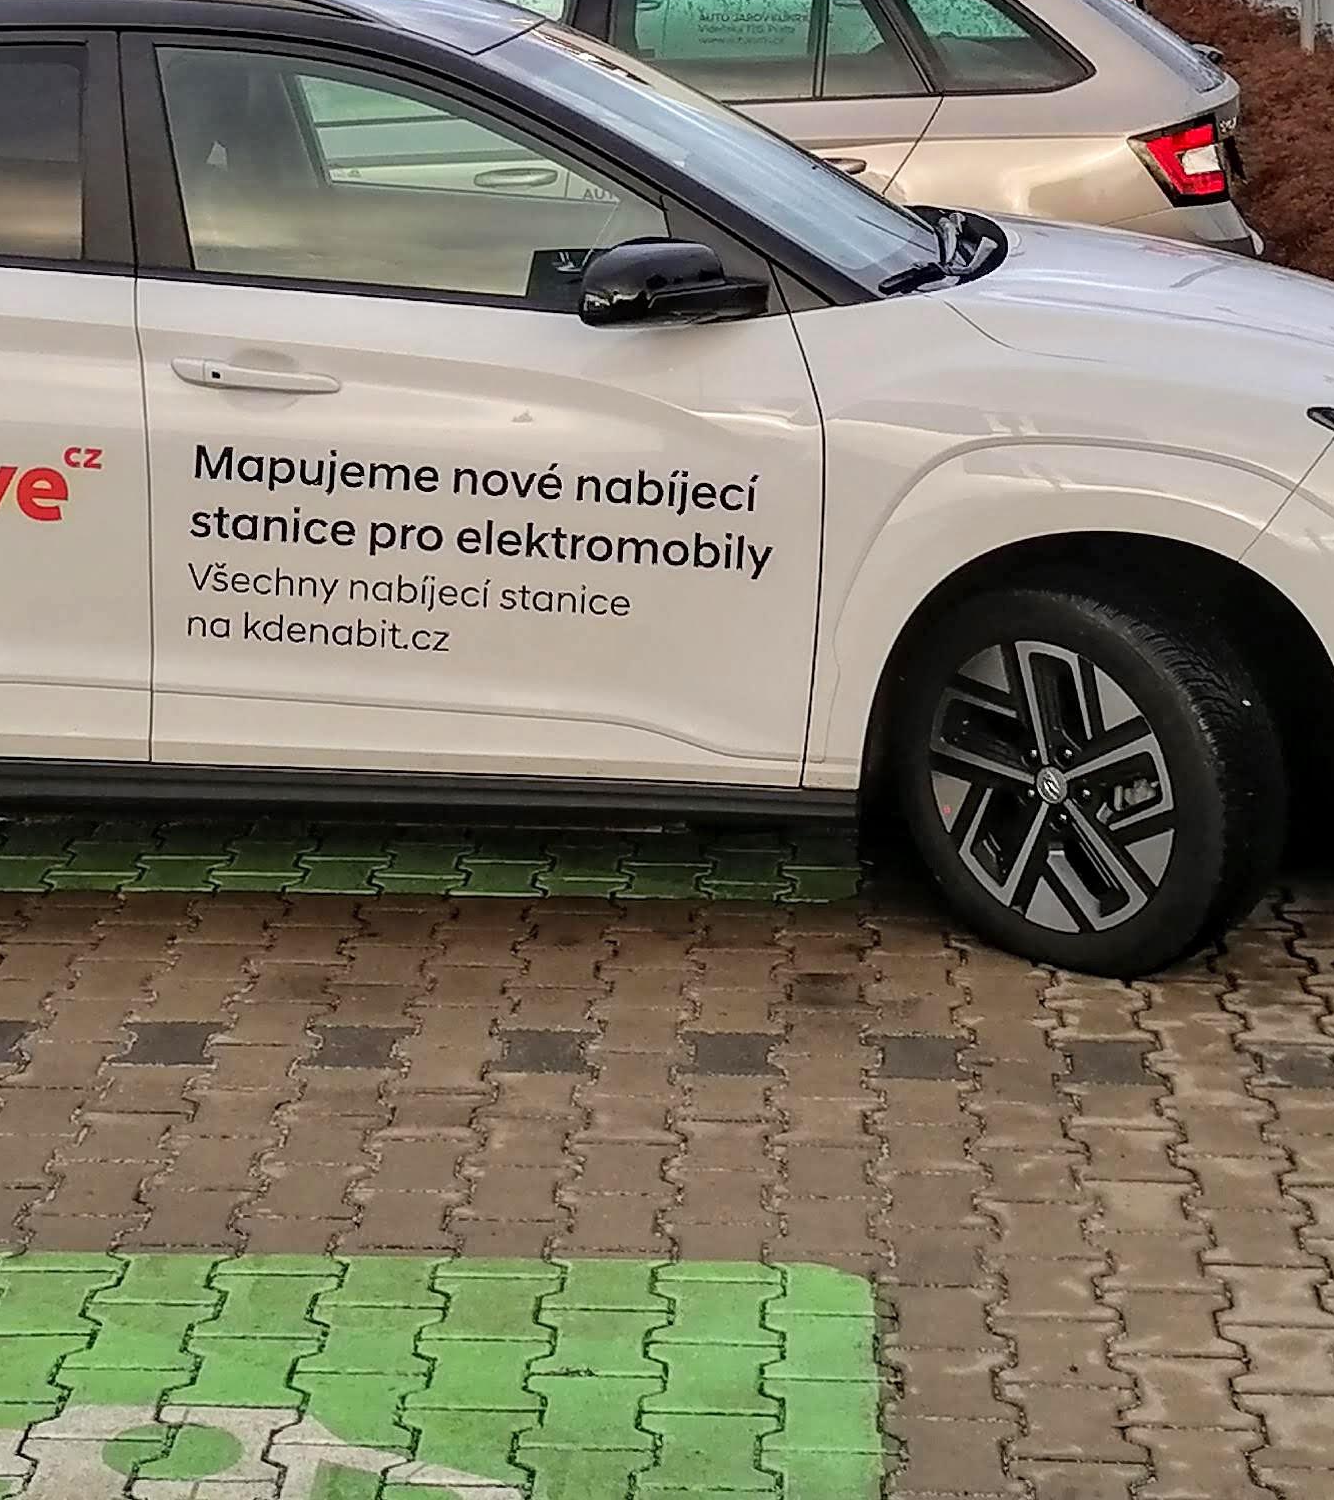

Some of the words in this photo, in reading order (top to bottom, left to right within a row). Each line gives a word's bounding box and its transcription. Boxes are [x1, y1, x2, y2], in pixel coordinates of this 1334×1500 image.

[699, 12, 731, 22] AUTO
[194, 444, 440, 495] Mapujeme
[453, 462, 563, 501] nové
[575, 468, 760, 516] nabíjecí
[189, 506, 356, 547] stanice
[369, 521, 444, 556] pro
[456, 519, 774, 580] elektromobily
[187, 562, 339, 605] Všechny
[349, 574, 492, 612] nabíjecí
[499, 584, 632, 616] stanice
[187, 615, 231, 638] na
[243, 611, 450, 652] kdenabit.cz
